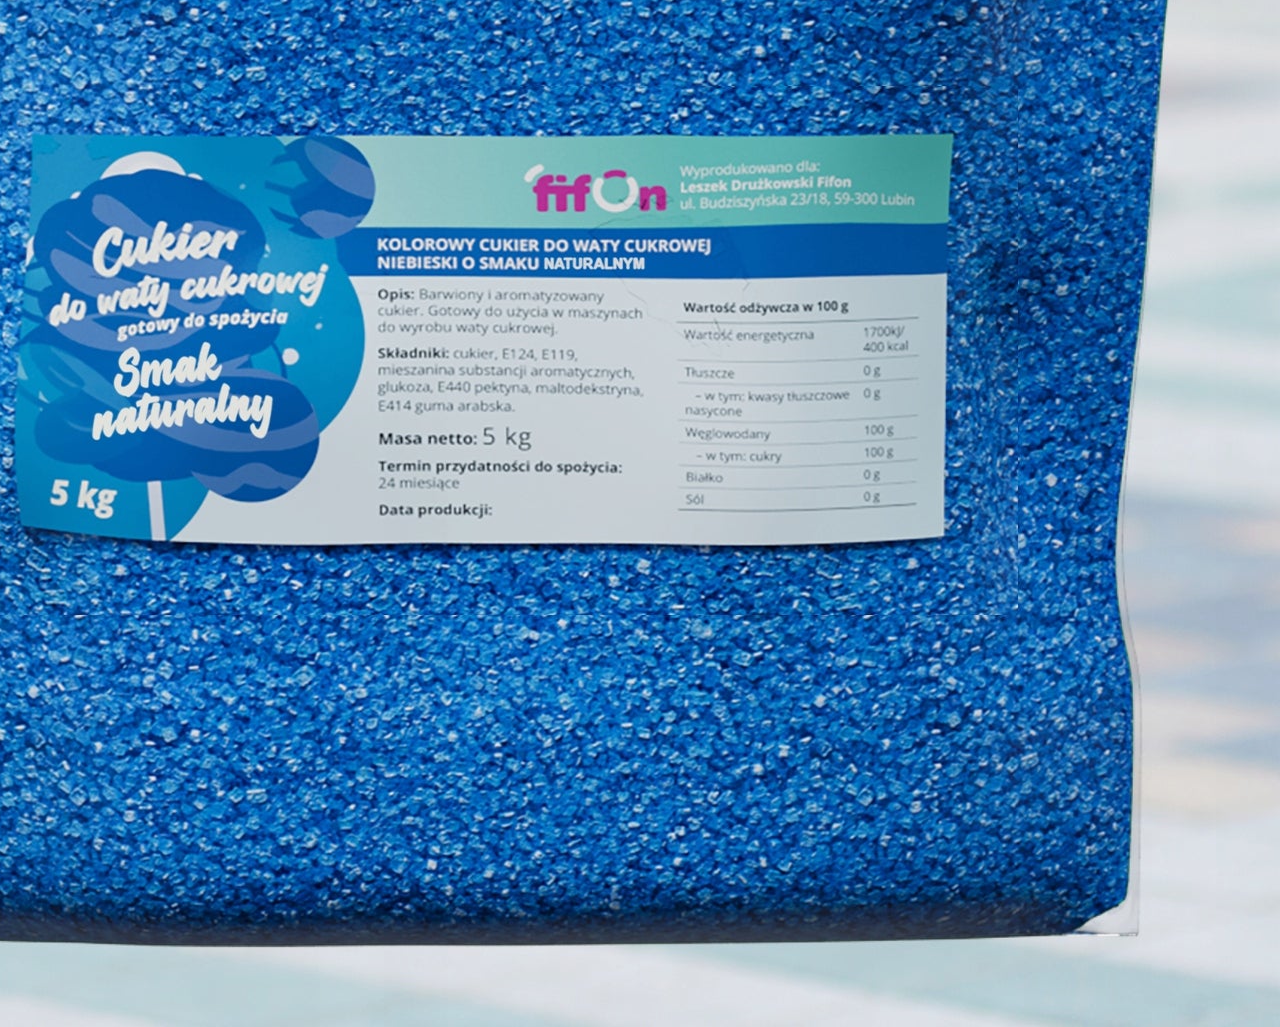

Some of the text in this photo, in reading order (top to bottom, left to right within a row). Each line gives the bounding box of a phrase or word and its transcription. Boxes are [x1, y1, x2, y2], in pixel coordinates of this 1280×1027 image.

[680, 161, 820, 179] Wyprodukowano dla:
[680, 176, 852, 193] Leszek Drużkowski Fifon
[680, 192, 915, 210] ul. Budziszyńska 23/18, 59-300 Lubin
[92, 220, 238, 277] Cukier
[377, 238, 711, 255] KOLOROWY CUKIER DO WATY CUKROWEJ
[377, 256, 645, 270] NIEBIESKI O SMAKU NATURALNYM
[49, 264, 329, 326] do waty cukrowej
[378, 288, 605, 304] Opis: Barwiony i aromatyzowany
[378, 305, 424, 317] cukier.
[428, 306, 481, 320] Gotowy
[484, 307, 502, 318] do
[552, 309, 563, 318] w
[568, 307, 643, 321] maszynach
[684, 301, 849, 316] Wartość odżywcza w 100 g
[117, 309, 288, 342] gotowy do spożycia
[378, 321, 558, 338] do wyrobu waty cukrowej.
[684, 329, 814, 344] Wartość energetyczna
[863, 340, 909, 353] 400 kcal
[378, 347, 578, 362] Składniki: cukier, E124, E119,
[113, 342, 222, 397] Smak
[378, 364, 635, 381] mieszanina substancji aromatycznych,
[685, 366, 735, 379] Tłuszcze
[863, 365, 881, 377] 0 g
[378, 381, 644, 398] glukoza, E440 pektyna, maltodekstryna,
[704, 392, 716, 401] w
[748, 391, 784, 403] kwasy
[787, 390, 850, 402] tłuszczowe
[863, 388, 881, 400] 0 g
[92, 383, 273, 441] naturalny
[378, 399, 516, 415] E414 guma arabska.
[685, 406, 743, 418] nasycone
[685, 427, 771, 441] Węglowodany
[865, 424, 894, 437] 100 g
[379, 426, 532, 451] Masa netto: 5 kg
[706, 452, 717, 460] w
[719, 451, 747, 464] tym:
[749, 450, 782, 463] cukry
[865, 446, 894, 459] 100 g
[378, 459, 622, 475] Termin przydatności do spożycia:
[686, 472, 724, 483] Białko
[863, 470, 880, 482] 0 g
[378, 477, 460, 491] 24 miesiące
[50, 479, 117, 519] 5 kg
[686, 493, 704, 505] Sól
[863, 491, 880, 503] 0 g
[379, 504, 493, 519] Data produkcji:
